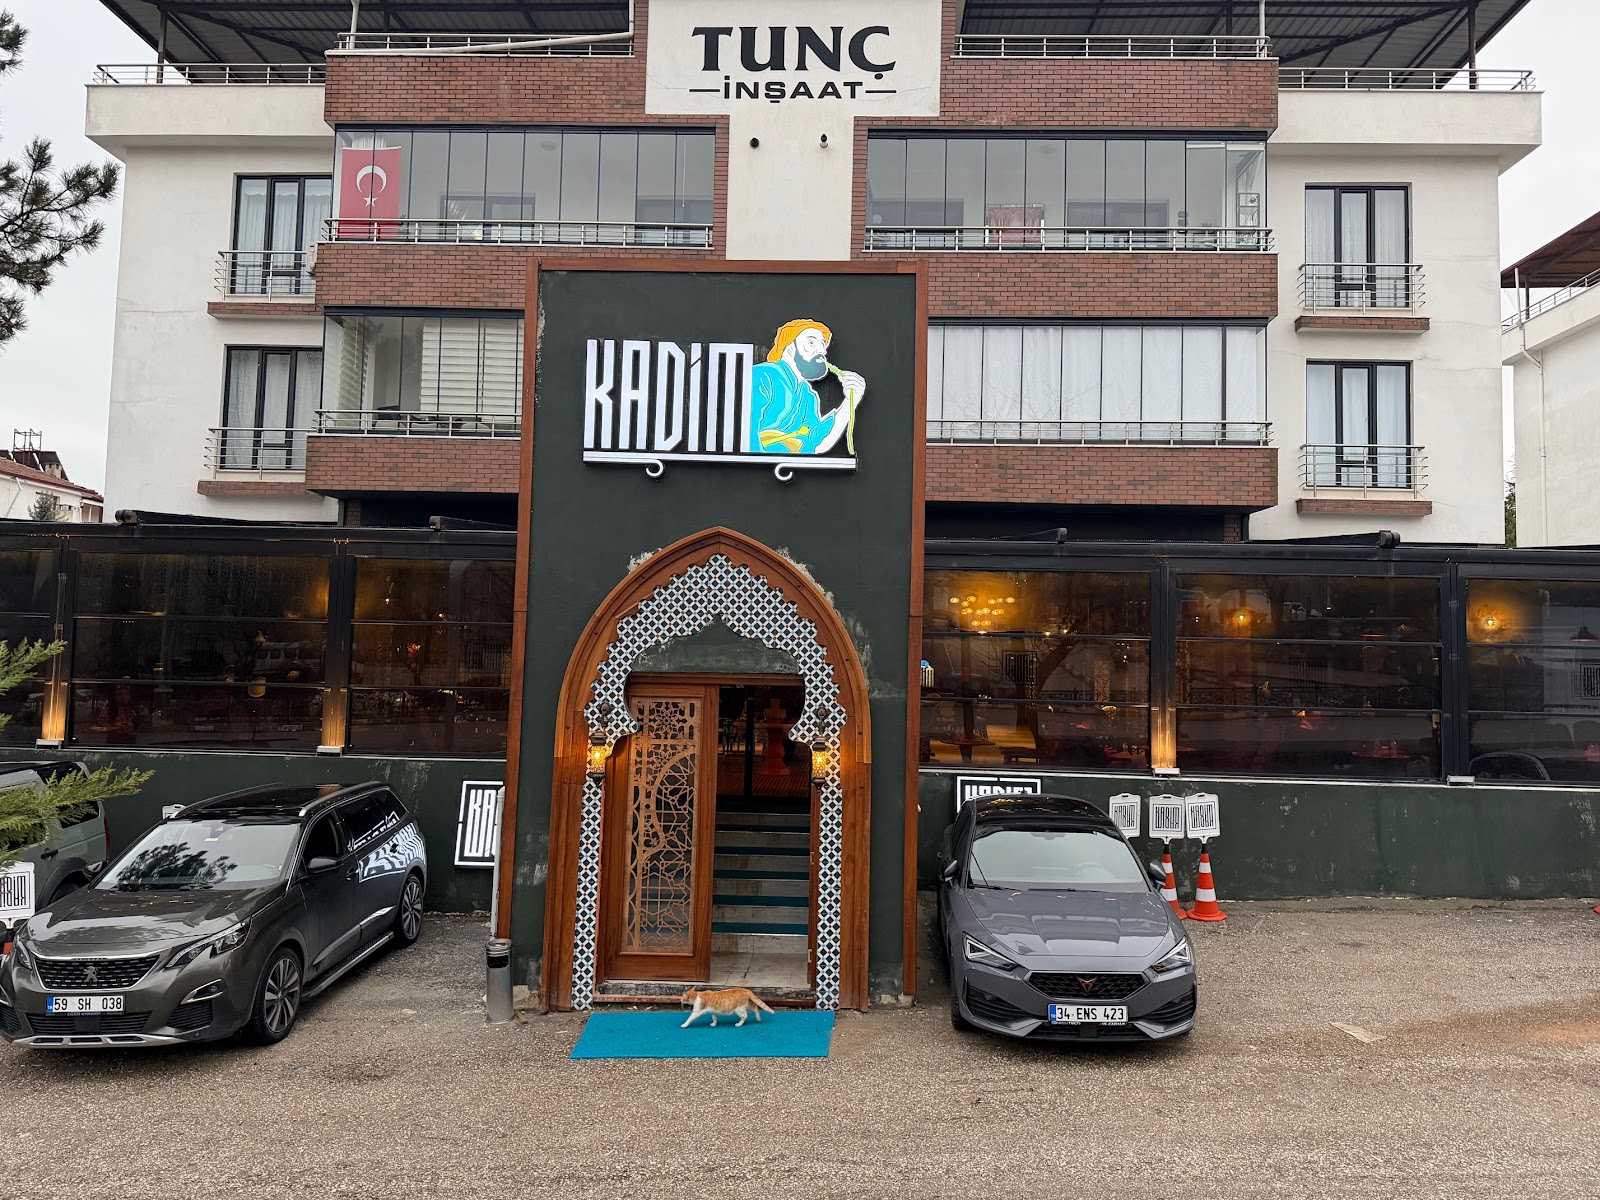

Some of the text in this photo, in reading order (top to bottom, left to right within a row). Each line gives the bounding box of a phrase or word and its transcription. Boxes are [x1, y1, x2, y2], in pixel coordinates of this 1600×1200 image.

[691, 25, 897, 81] TUNÇ
[723, 75, 864, 104] İNŞAAT
[584, 338, 754, 453] KADİM
[54, 998, 68, 1011] 59
[77, 998, 92, 1011] SH
[102, 997, 122, 1010] 038
[1057, 1007, 1071, 1020] 34
[1076, 1007, 1098, 1020] ENS
[1103, 1007, 1124, 1020] 423
